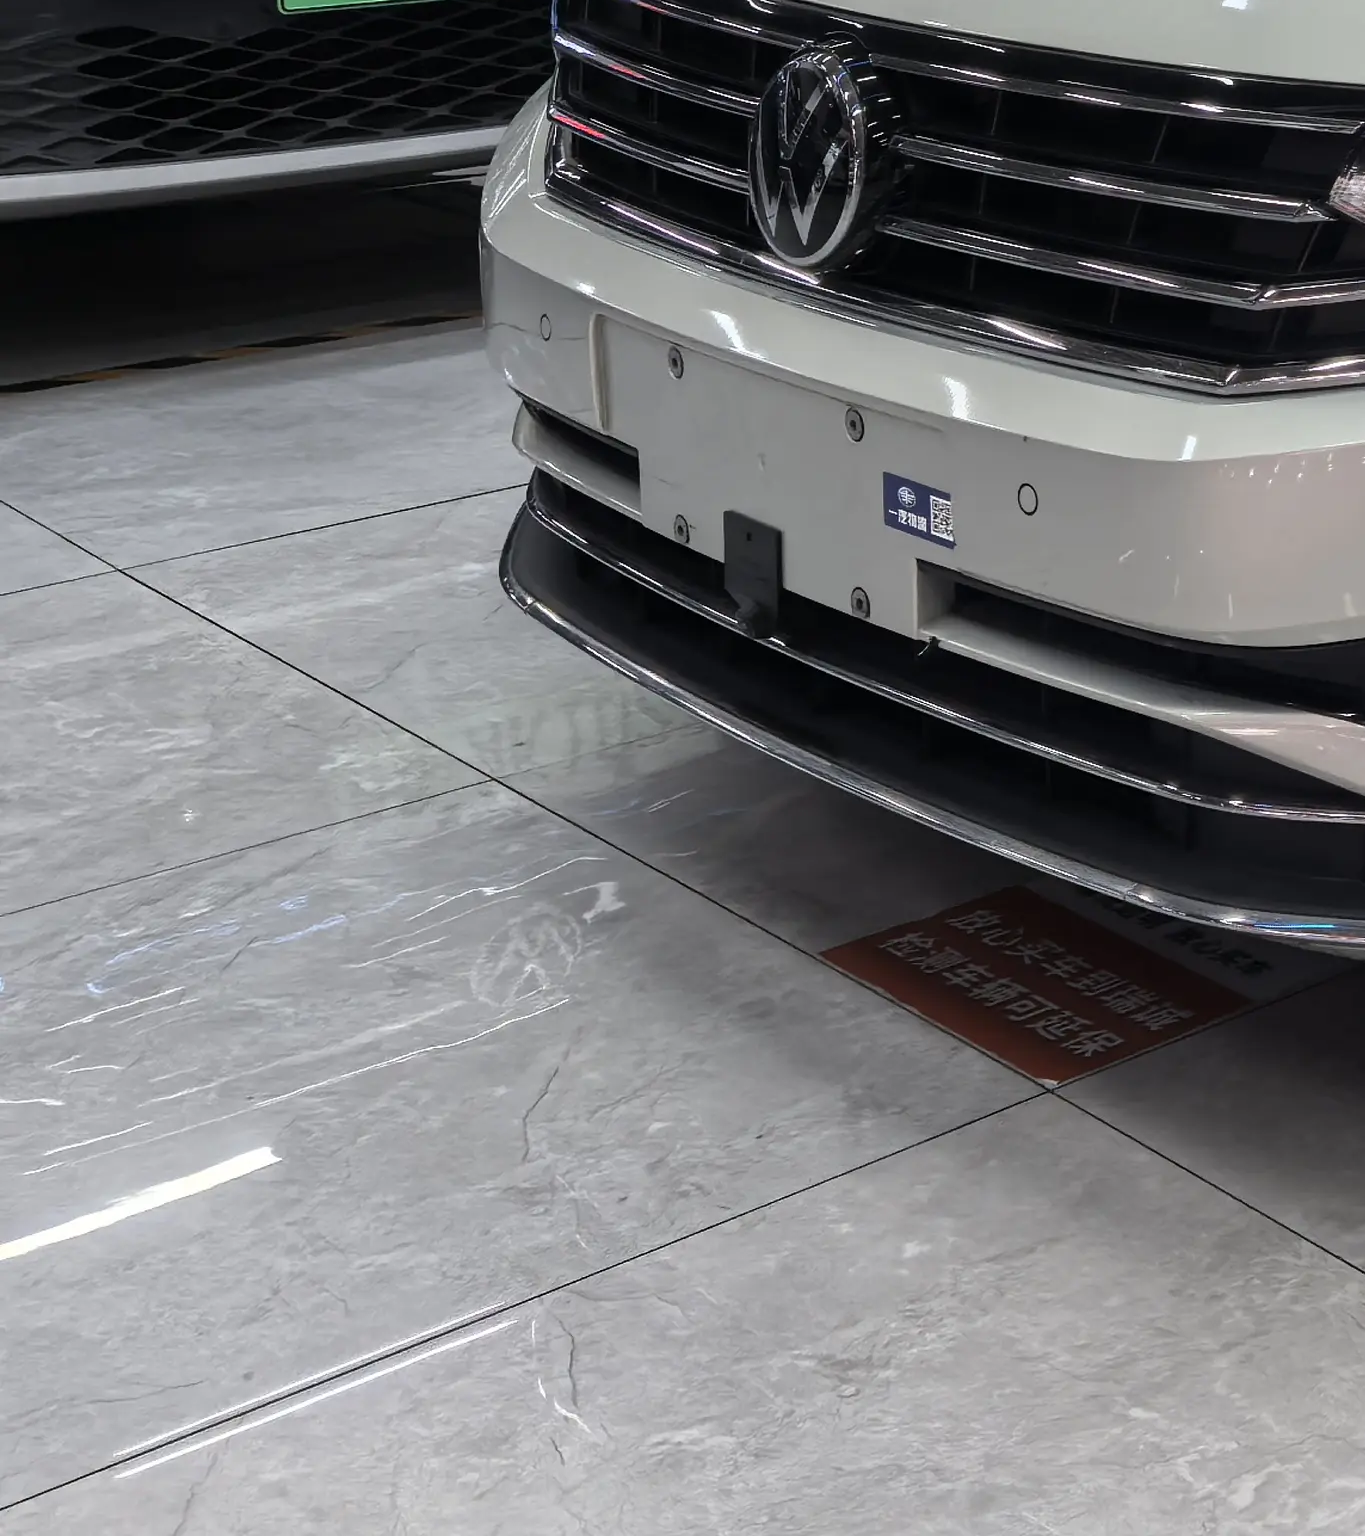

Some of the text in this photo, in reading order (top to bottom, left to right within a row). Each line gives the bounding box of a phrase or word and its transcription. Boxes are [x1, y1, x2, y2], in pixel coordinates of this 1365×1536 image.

[876, 929, 1127, 1058] 检测车辆可延保
[945, 908, 1196, 1032] 放心买车到瑞诚
